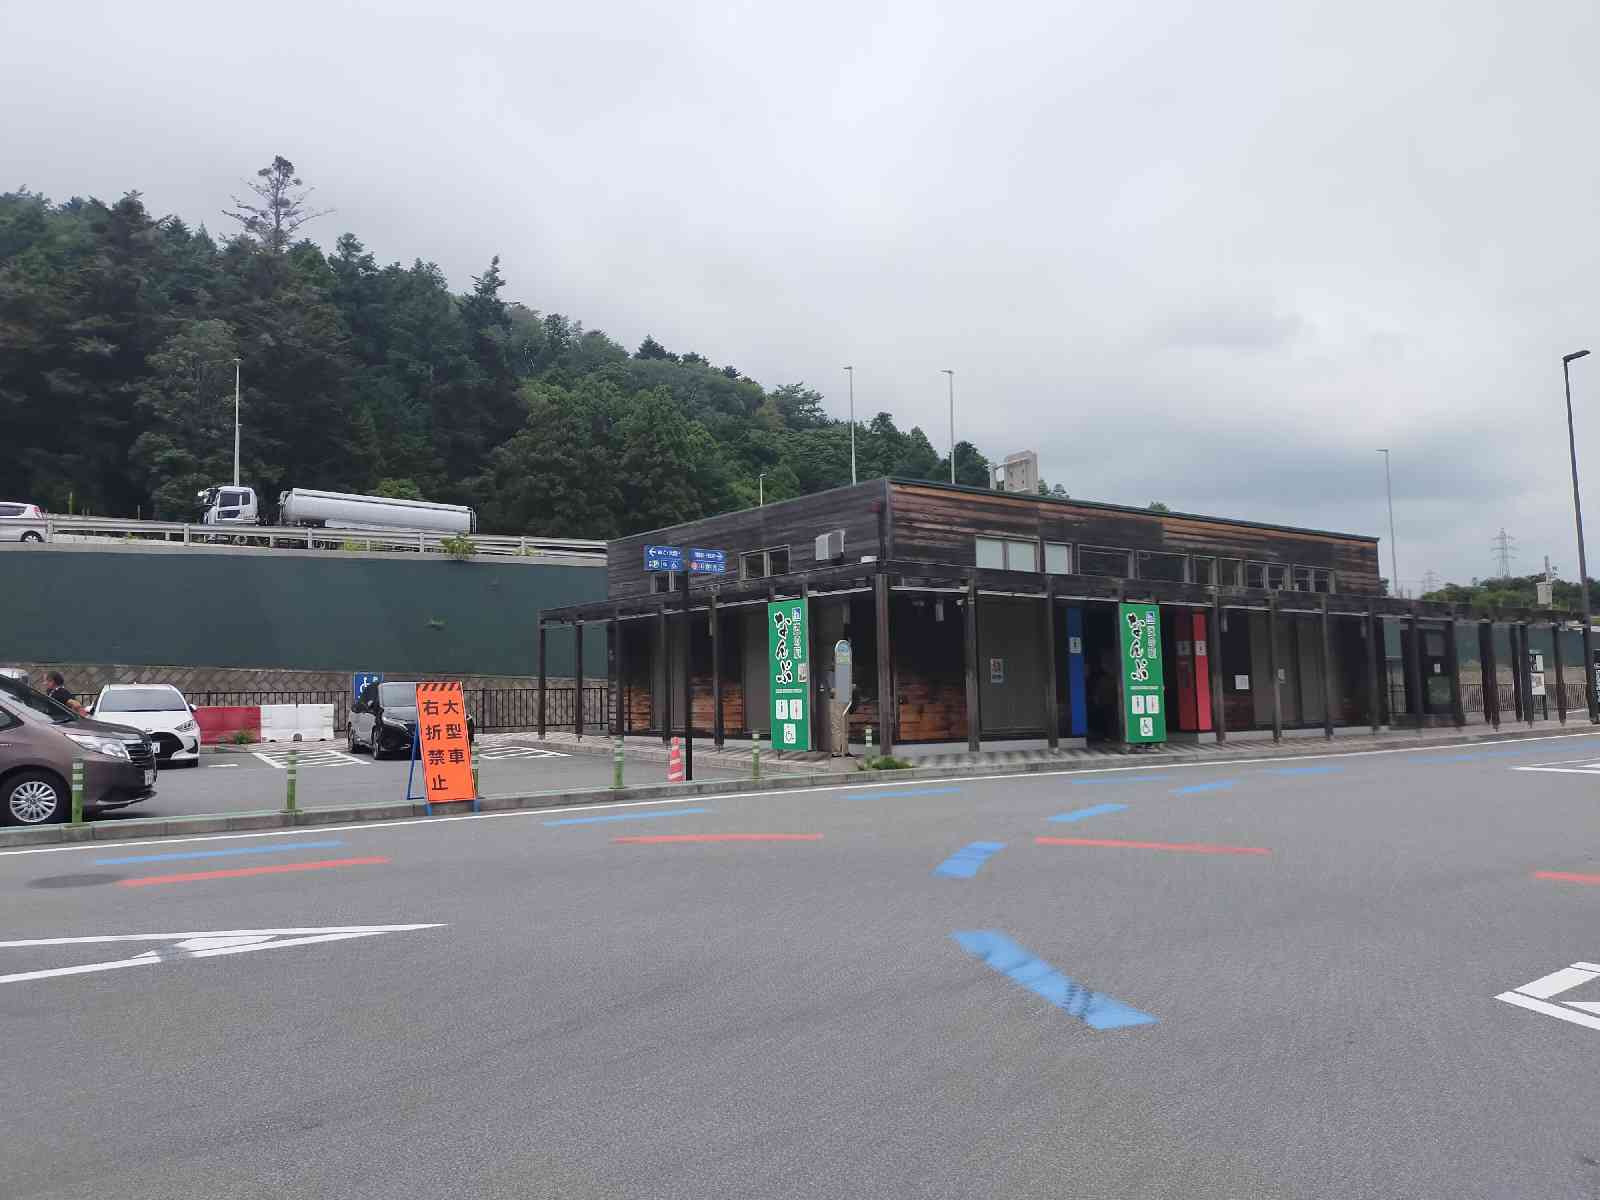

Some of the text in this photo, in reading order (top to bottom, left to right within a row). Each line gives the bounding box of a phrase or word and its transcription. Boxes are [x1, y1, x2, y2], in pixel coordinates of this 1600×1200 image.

[423, 699, 448, 791] 右折禁止
[443, 699, 465, 764] 大型車
